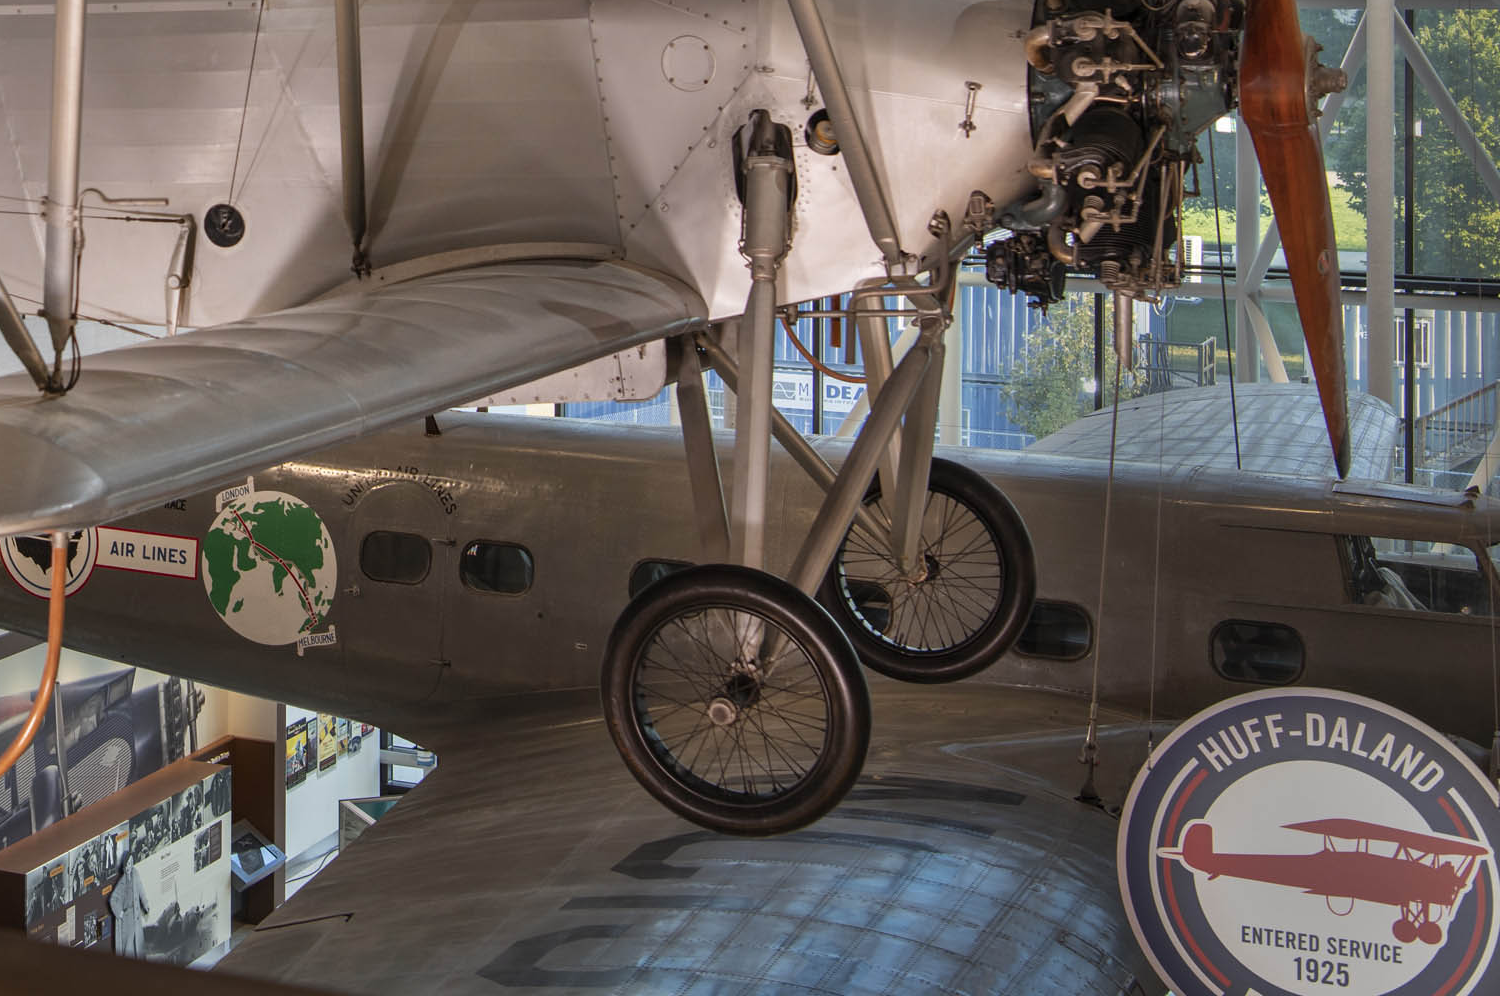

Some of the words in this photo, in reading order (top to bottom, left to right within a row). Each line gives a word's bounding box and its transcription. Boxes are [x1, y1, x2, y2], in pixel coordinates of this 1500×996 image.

[221, 486, 250, 501] LONDON
[110, 540, 135, 558] AIR
[143, 544, 188, 565] LINES
[299, 633, 335, 647] MELBOURNE
[1198, 713, 1445, 793] HUFF-DALAND
[1241, 925, 1320, 953] ENTERED
[1327, 936, 1404, 964] SERVICE
[1293, 956, 1350, 987] 1925
